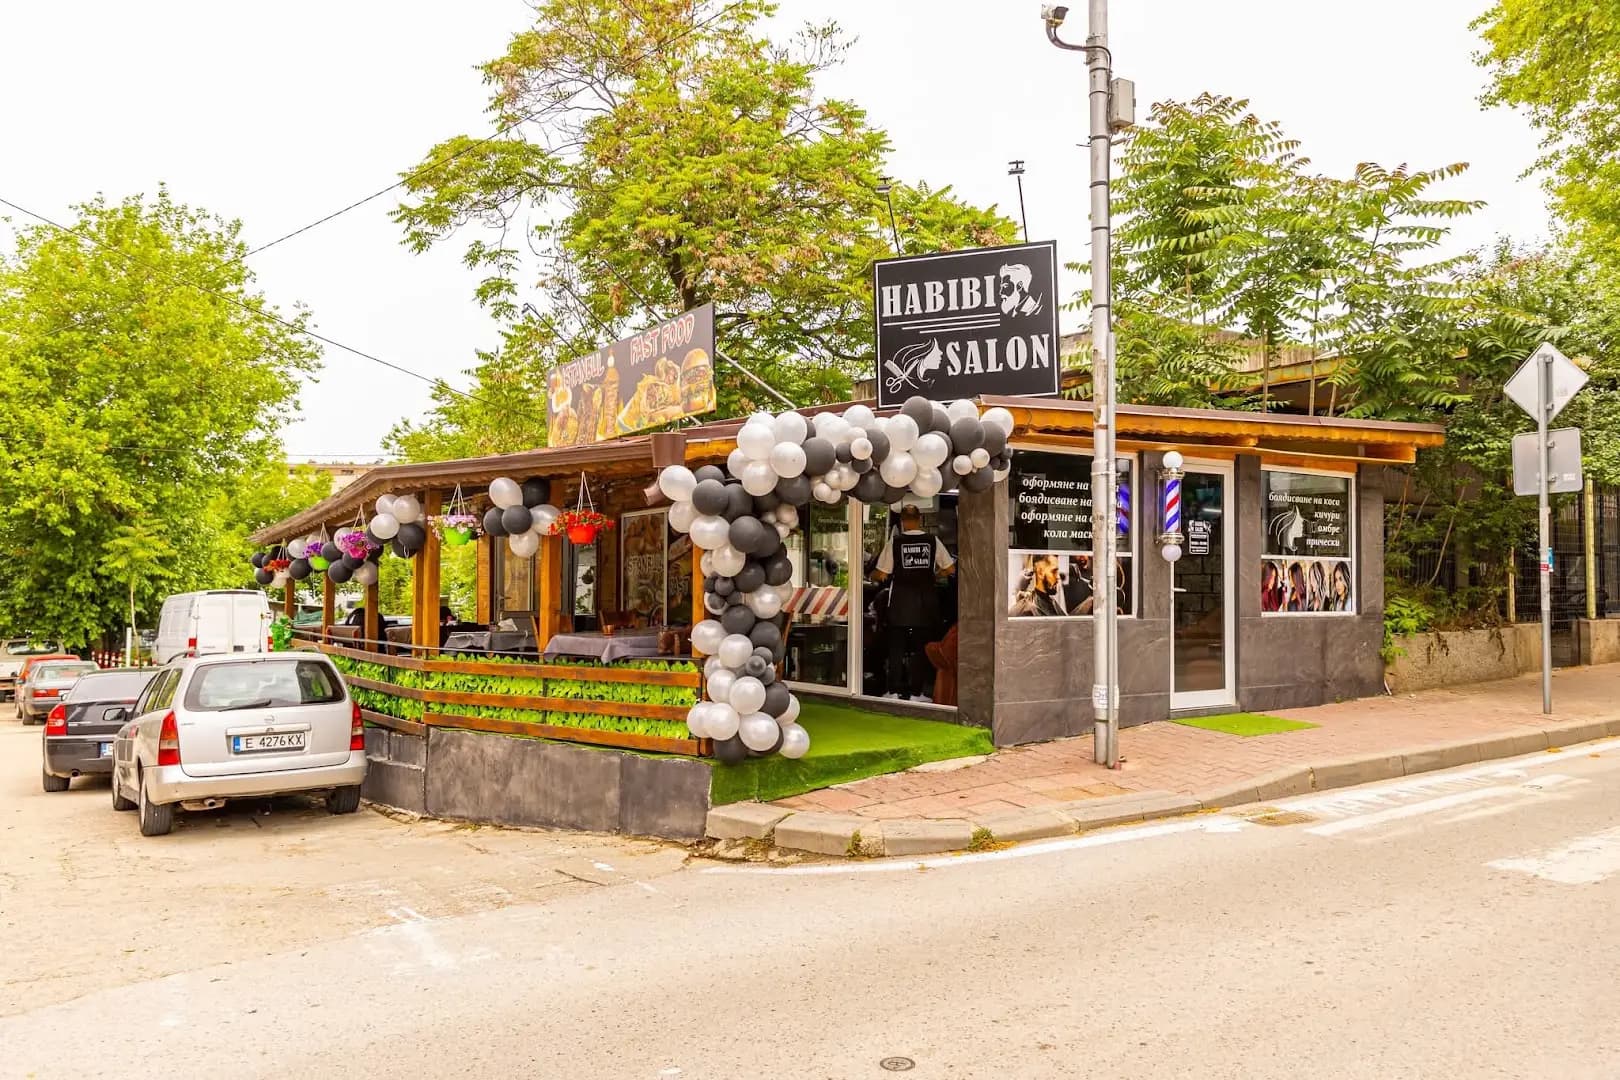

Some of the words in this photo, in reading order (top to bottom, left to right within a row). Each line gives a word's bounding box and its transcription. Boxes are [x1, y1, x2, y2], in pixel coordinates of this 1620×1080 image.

[881, 275, 997, 317] HABIBI
[630, 328, 660, 366] FAST
[661, 313, 695, 353] FOOD
[945, 333, 1050, 376] SALON
[1022, 476, 1075, 491] оформяне
[1076, 482, 1089, 491] на
[1018, 492, 1078, 506] боядисване
[1080, 498, 1093, 507] на
[1313, 497, 1323, 505] на
[1021, 509, 1074, 524] оформяне
[1075, 515, 1088, 523] на
[1043, 529, 1068, 538] кола
[1069, 530, 1093, 539] маск
[245, 738, 254, 749] E
[259, 735, 286, 747] 4276
[287, 734, 302, 745] KX
